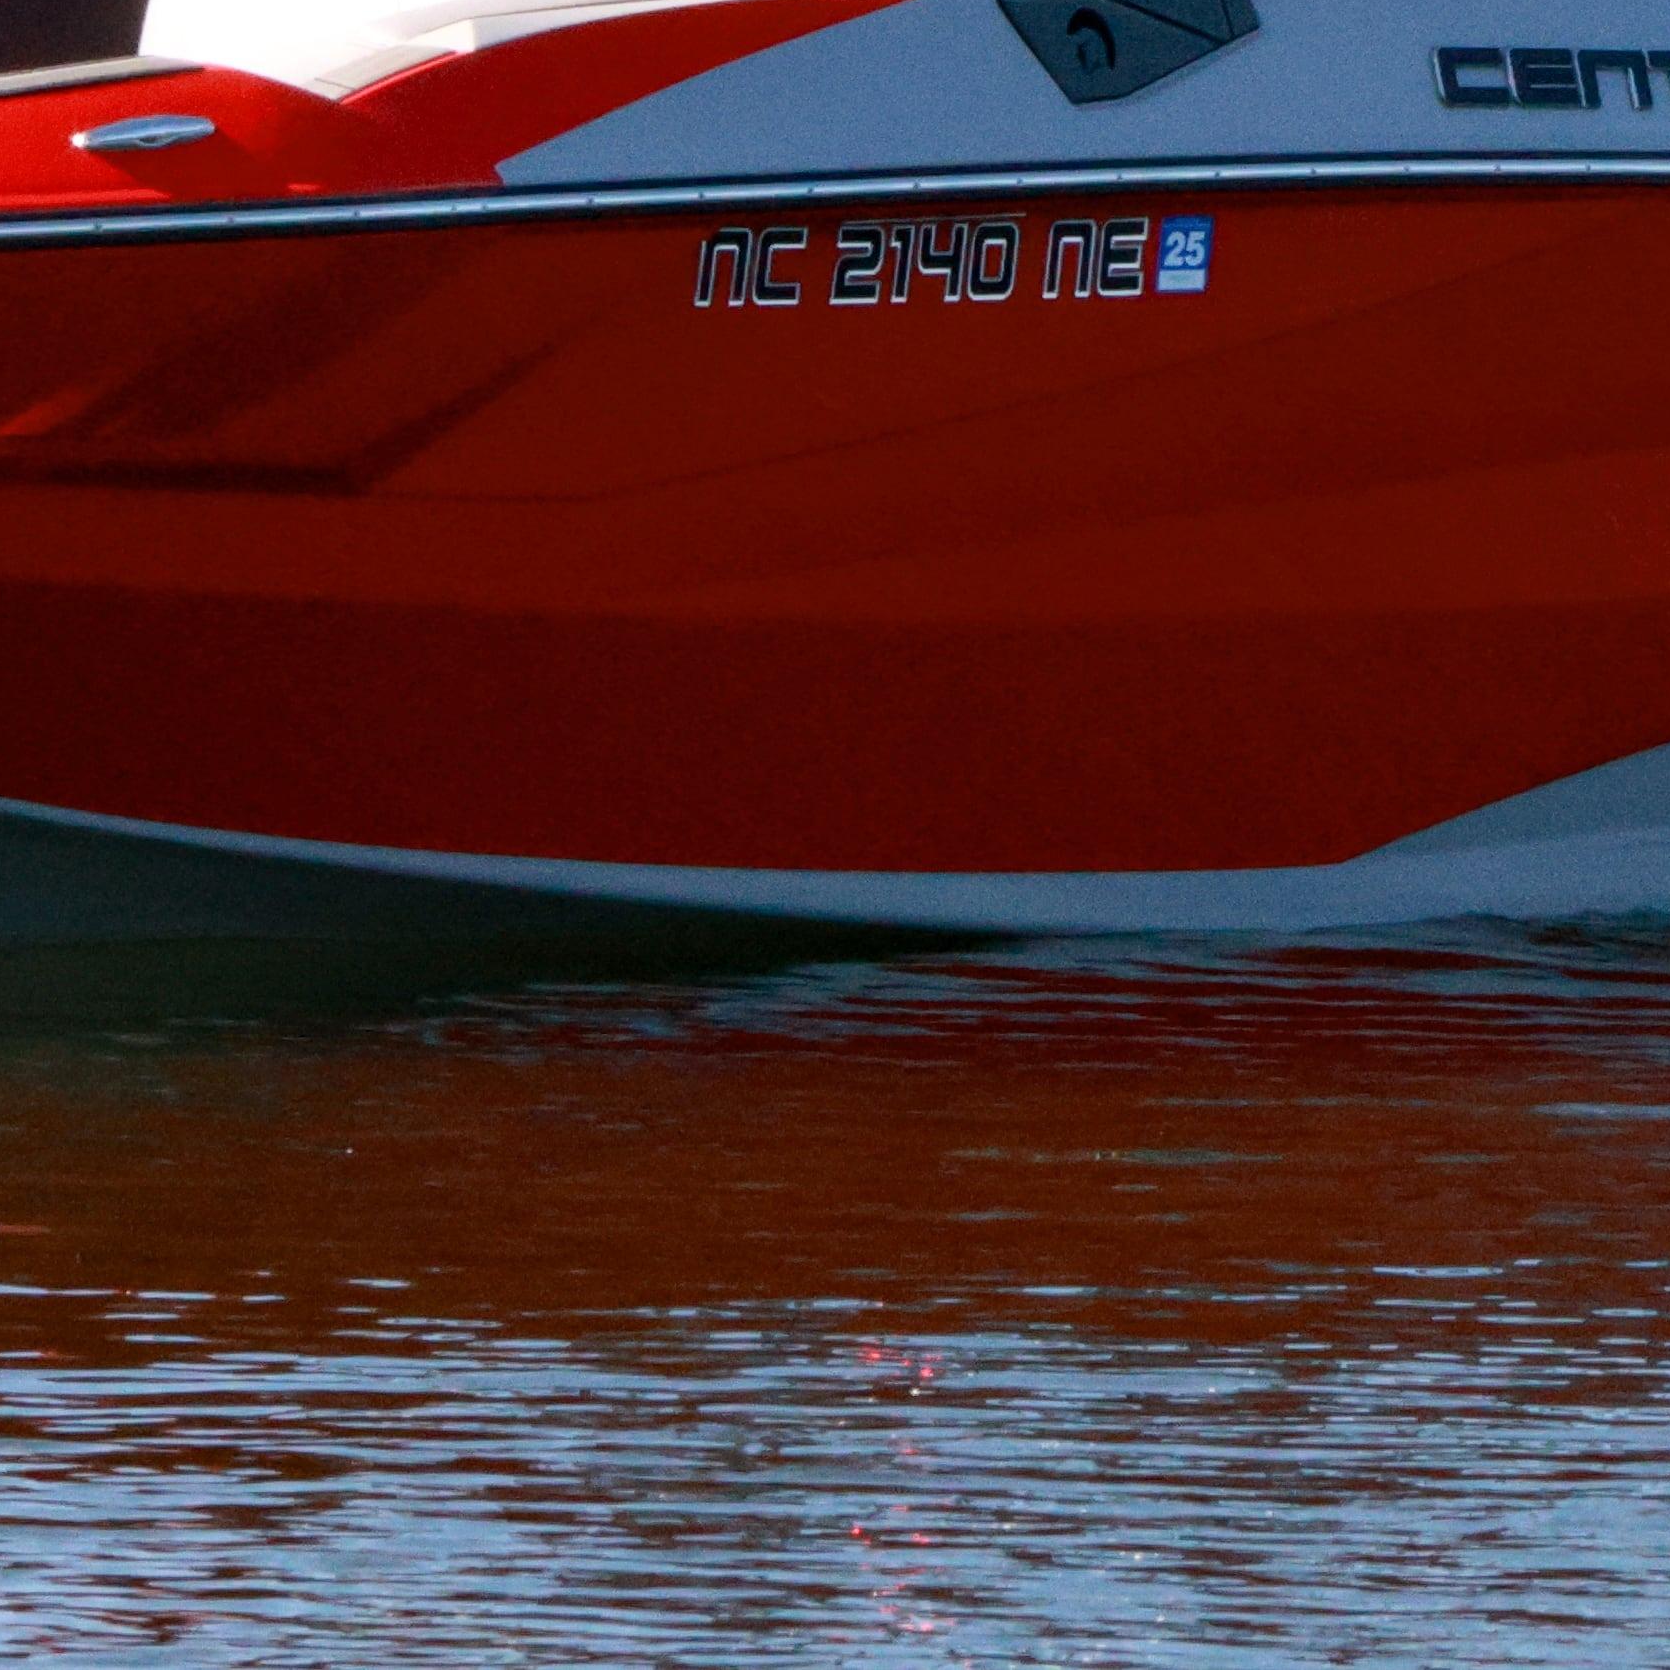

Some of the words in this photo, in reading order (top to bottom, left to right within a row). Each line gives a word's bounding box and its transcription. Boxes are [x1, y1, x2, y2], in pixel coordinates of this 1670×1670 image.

[694, 226, 808, 306] NC
[829, 222, 1020, 306] 2140
[1042, 217, 1149, 299] NE
[1164, 231, 1206, 267] 25
